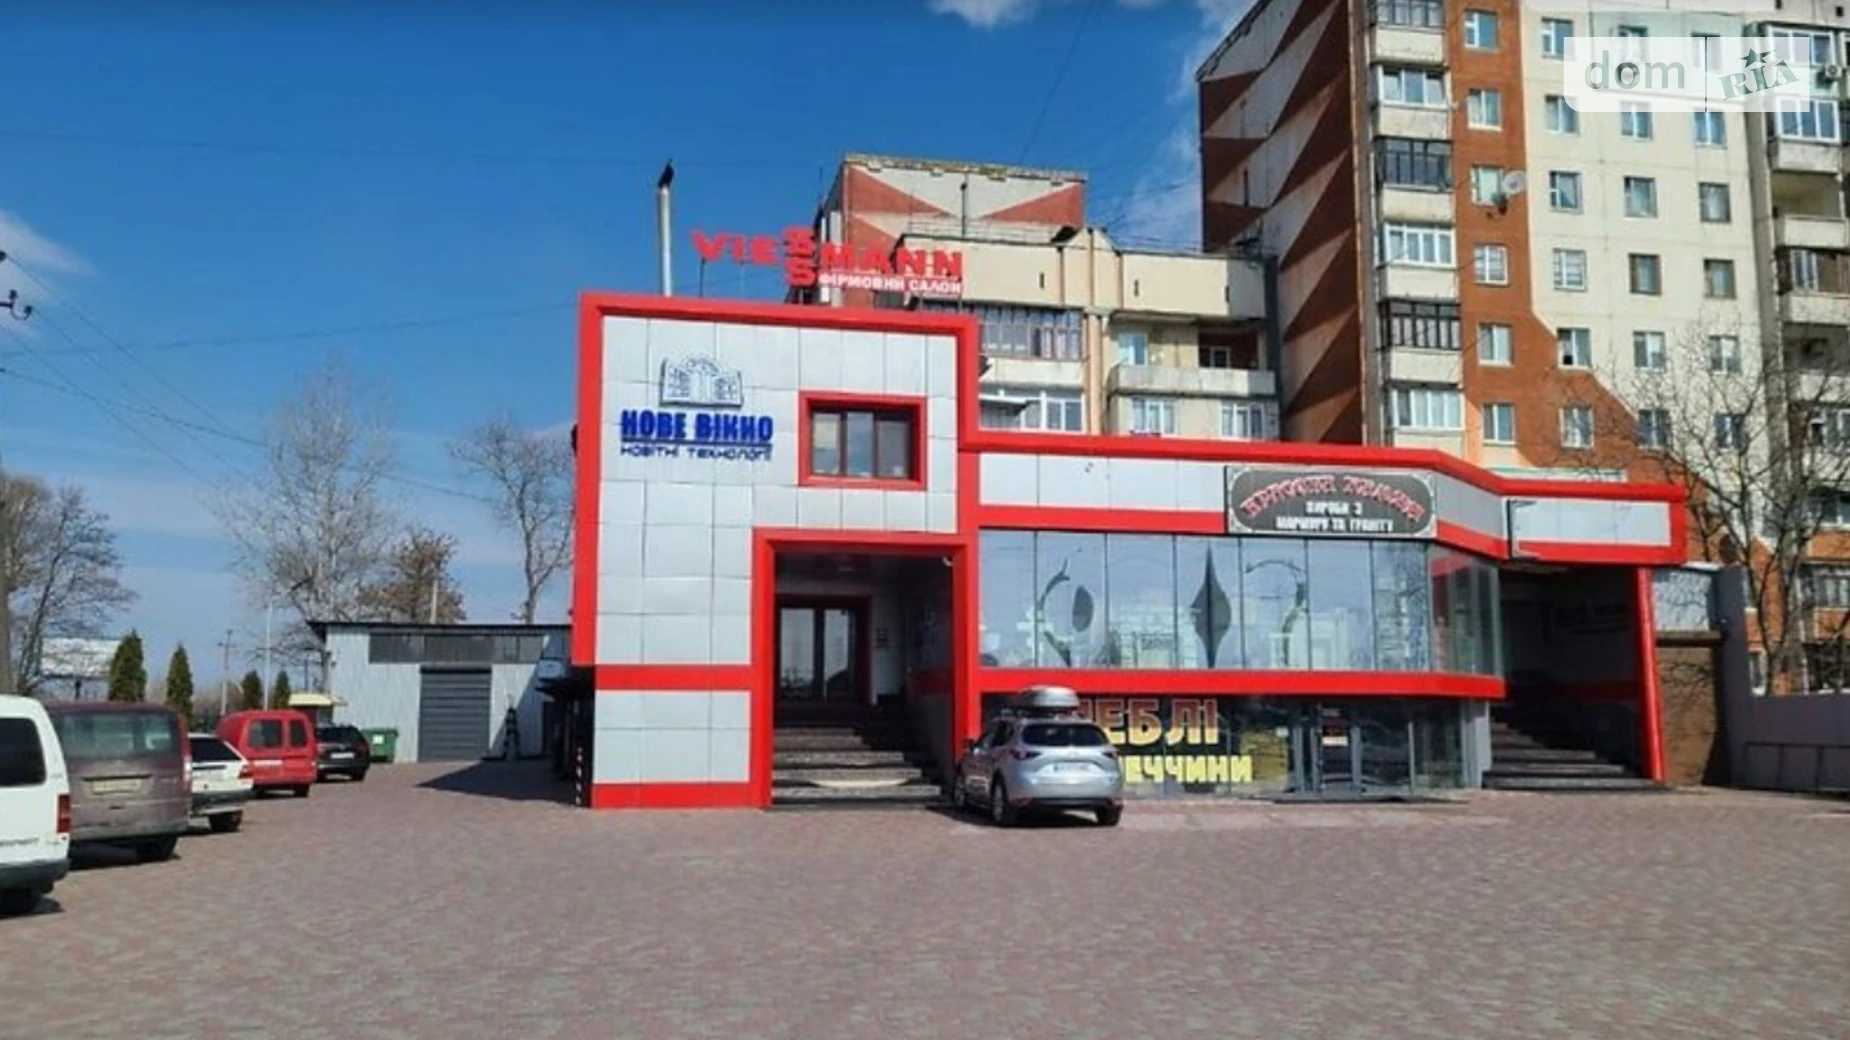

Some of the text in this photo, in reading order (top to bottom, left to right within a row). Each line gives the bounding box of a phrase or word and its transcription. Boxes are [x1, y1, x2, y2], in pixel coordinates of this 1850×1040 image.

[909, 278, 961, 293] САЛОН
[622, 410, 774, 442] НОВЕ ВІКНО
[1078, 698, 1219, 745] ЕБЛІ
[1117, 755, 1253, 783] ЕЧЧИНИ
